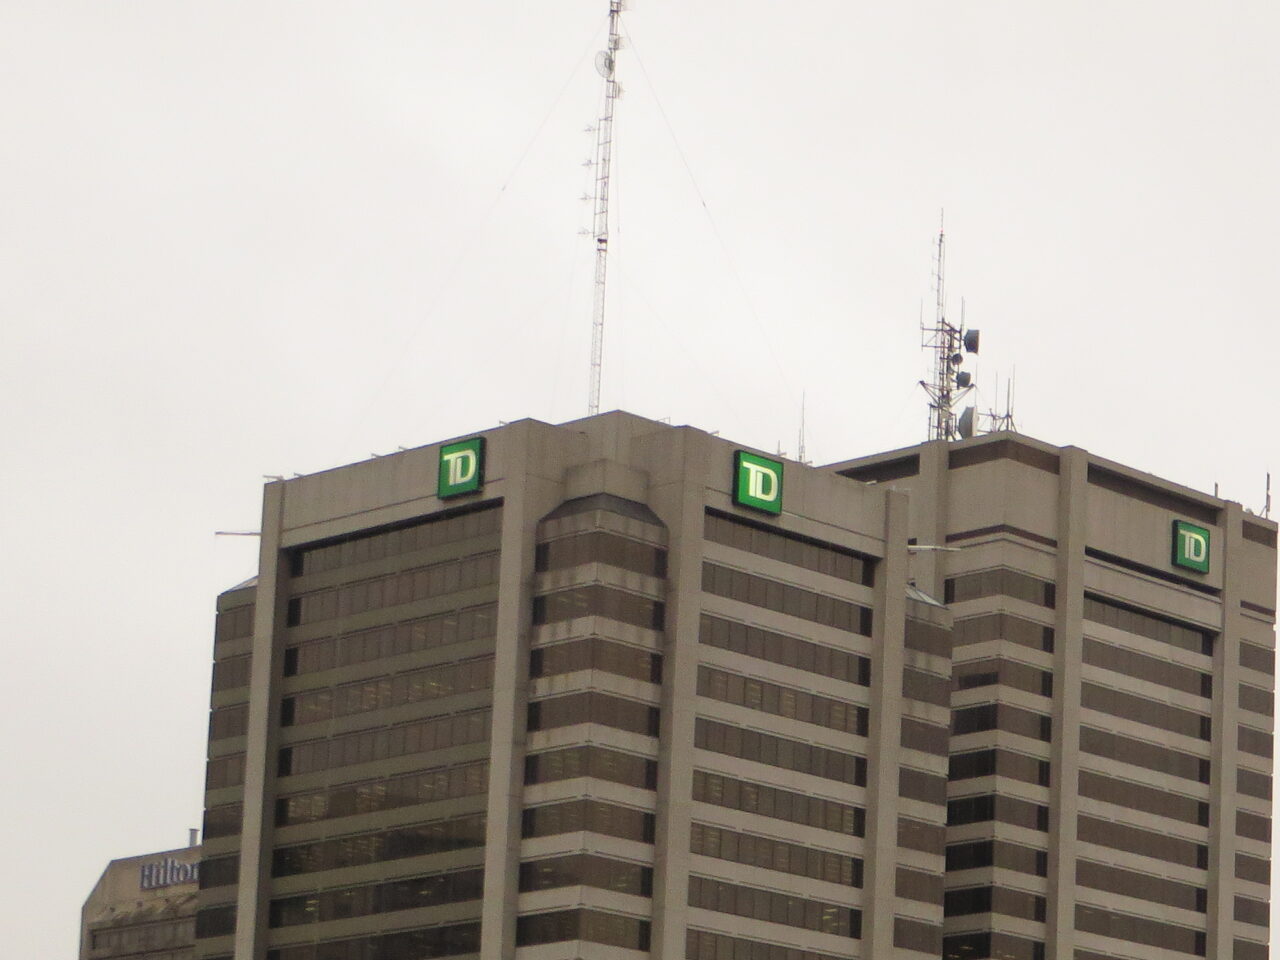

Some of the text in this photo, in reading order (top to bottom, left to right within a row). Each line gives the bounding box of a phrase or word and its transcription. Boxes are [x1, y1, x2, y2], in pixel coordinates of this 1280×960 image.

[444, 449, 476, 486] TD
[742, 461, 778, 502] TD
[1179, 529, 1206, 562] TD
